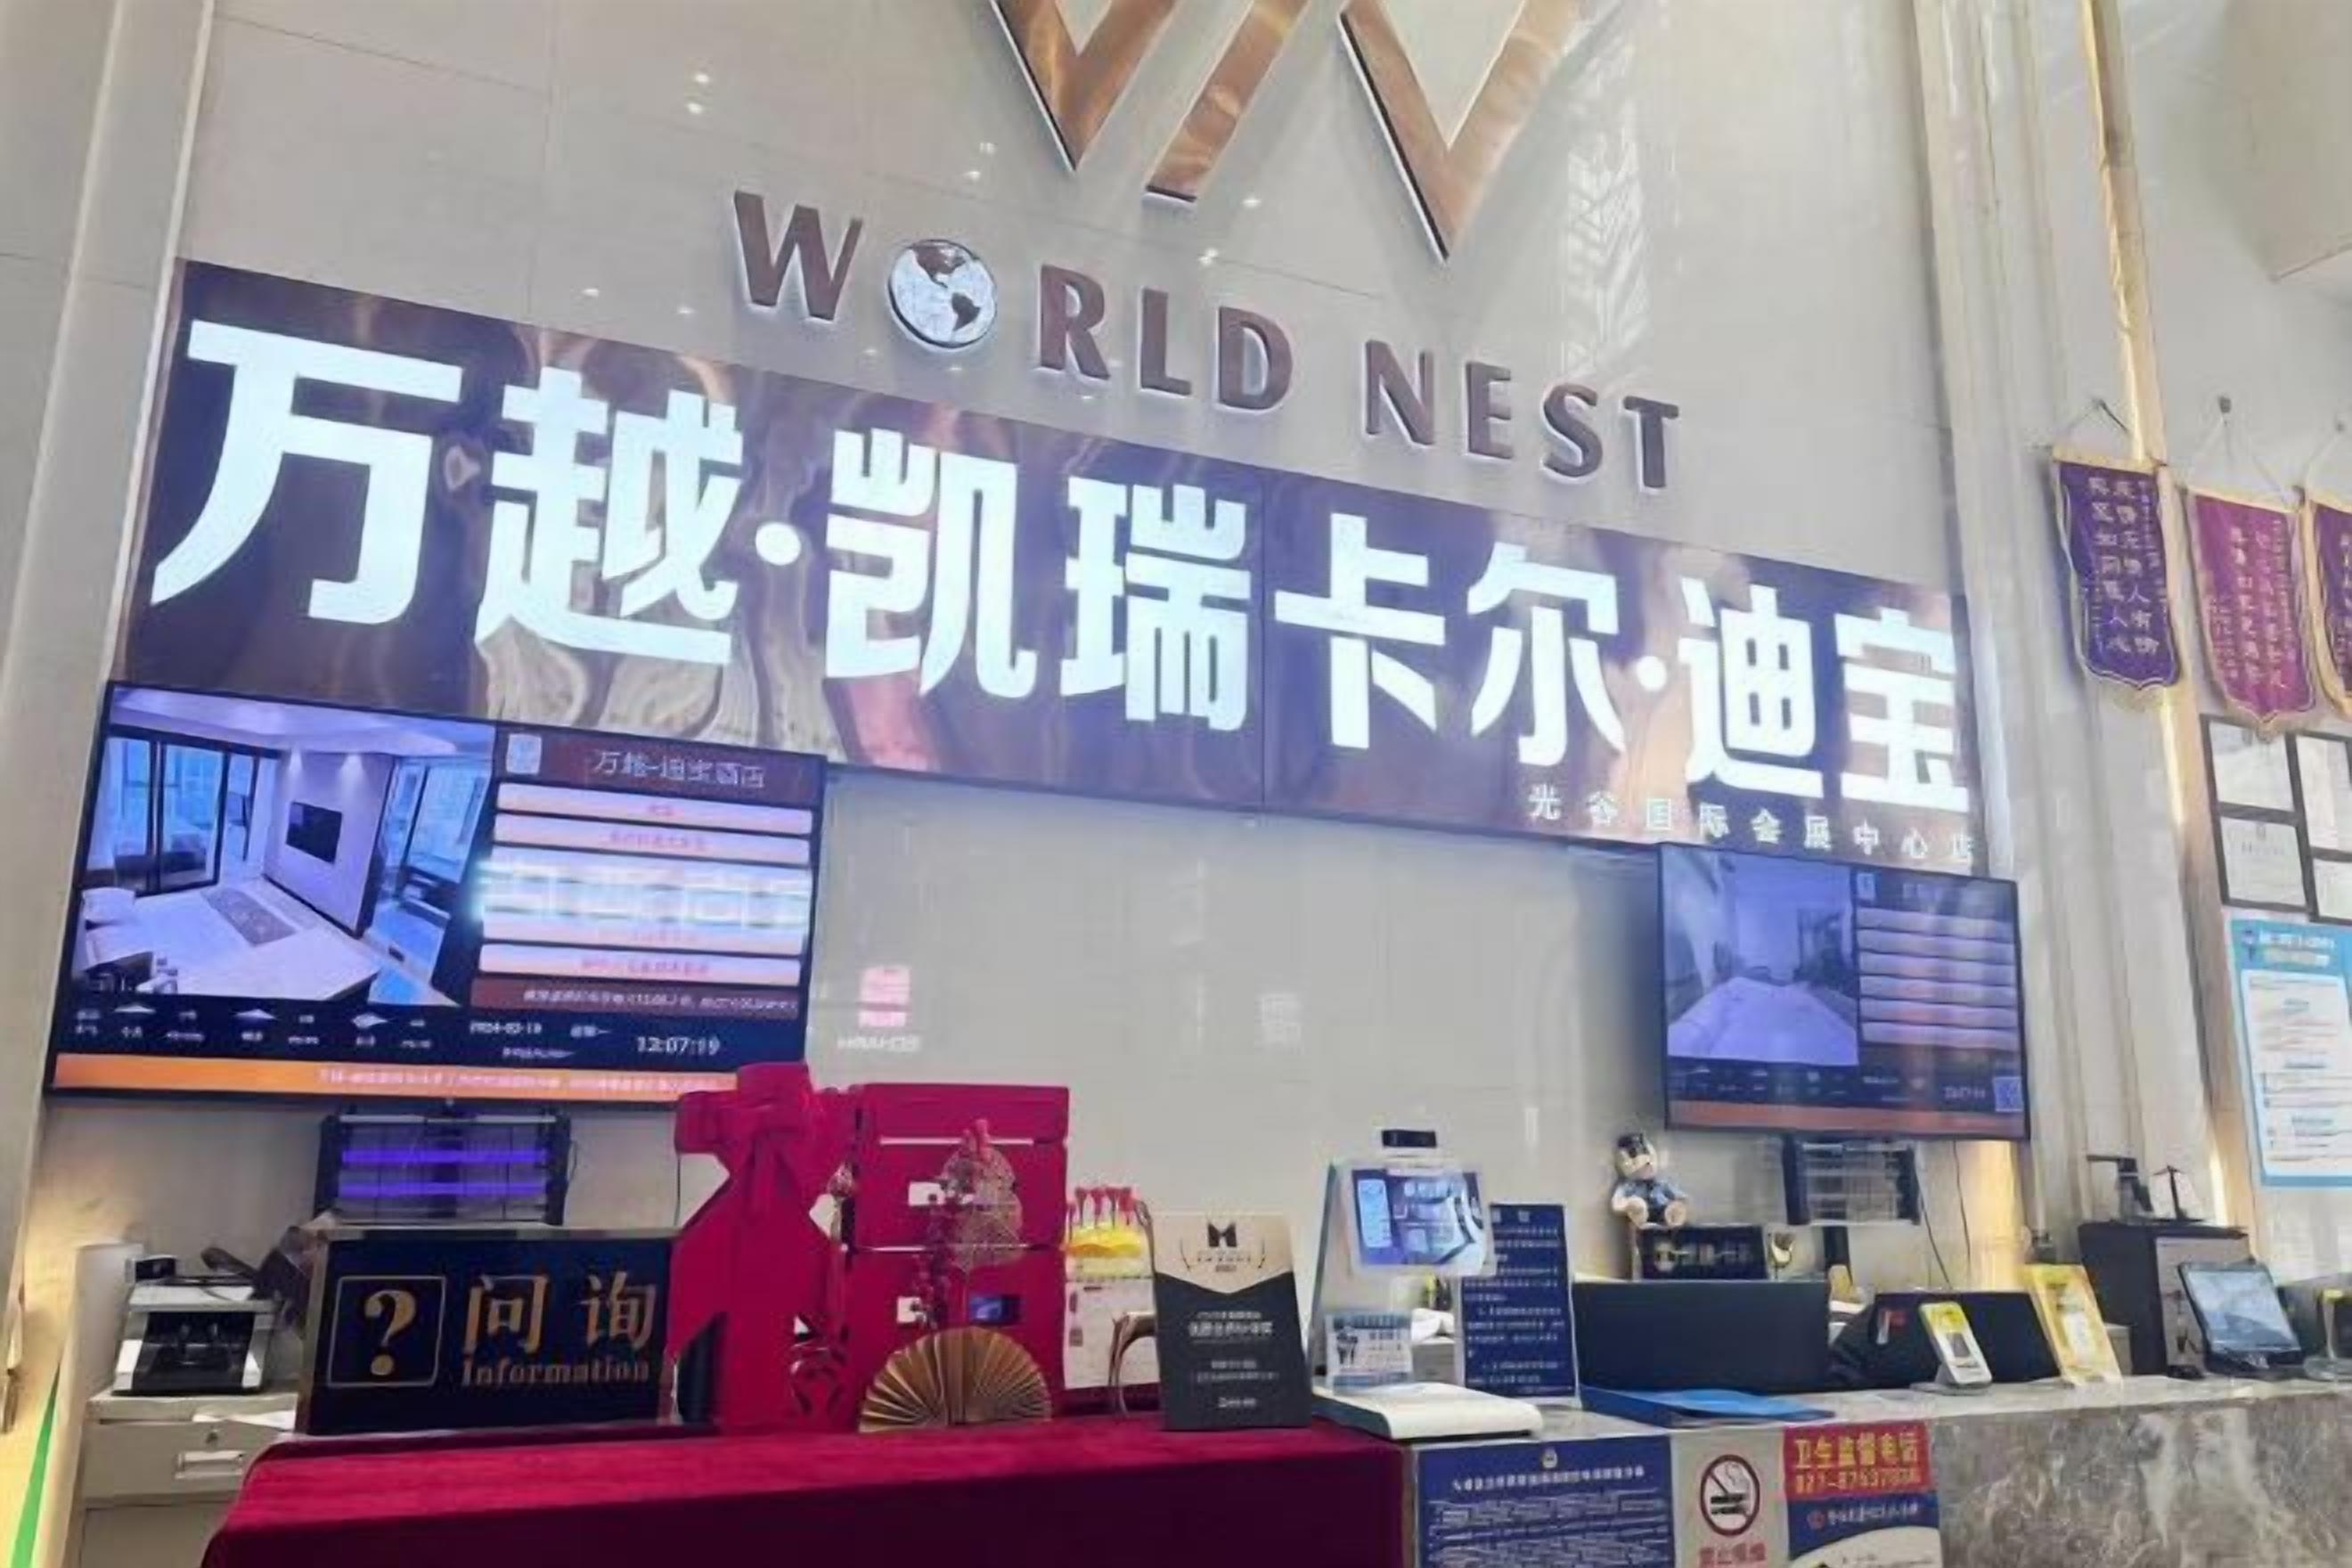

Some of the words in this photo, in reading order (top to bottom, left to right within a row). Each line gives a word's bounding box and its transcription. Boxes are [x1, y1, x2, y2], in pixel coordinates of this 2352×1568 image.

[1363, 340, 1680, 489] NEST
[461, 1270, 657, 1355] 问询
[461, 1354, 650, 1387] Information
